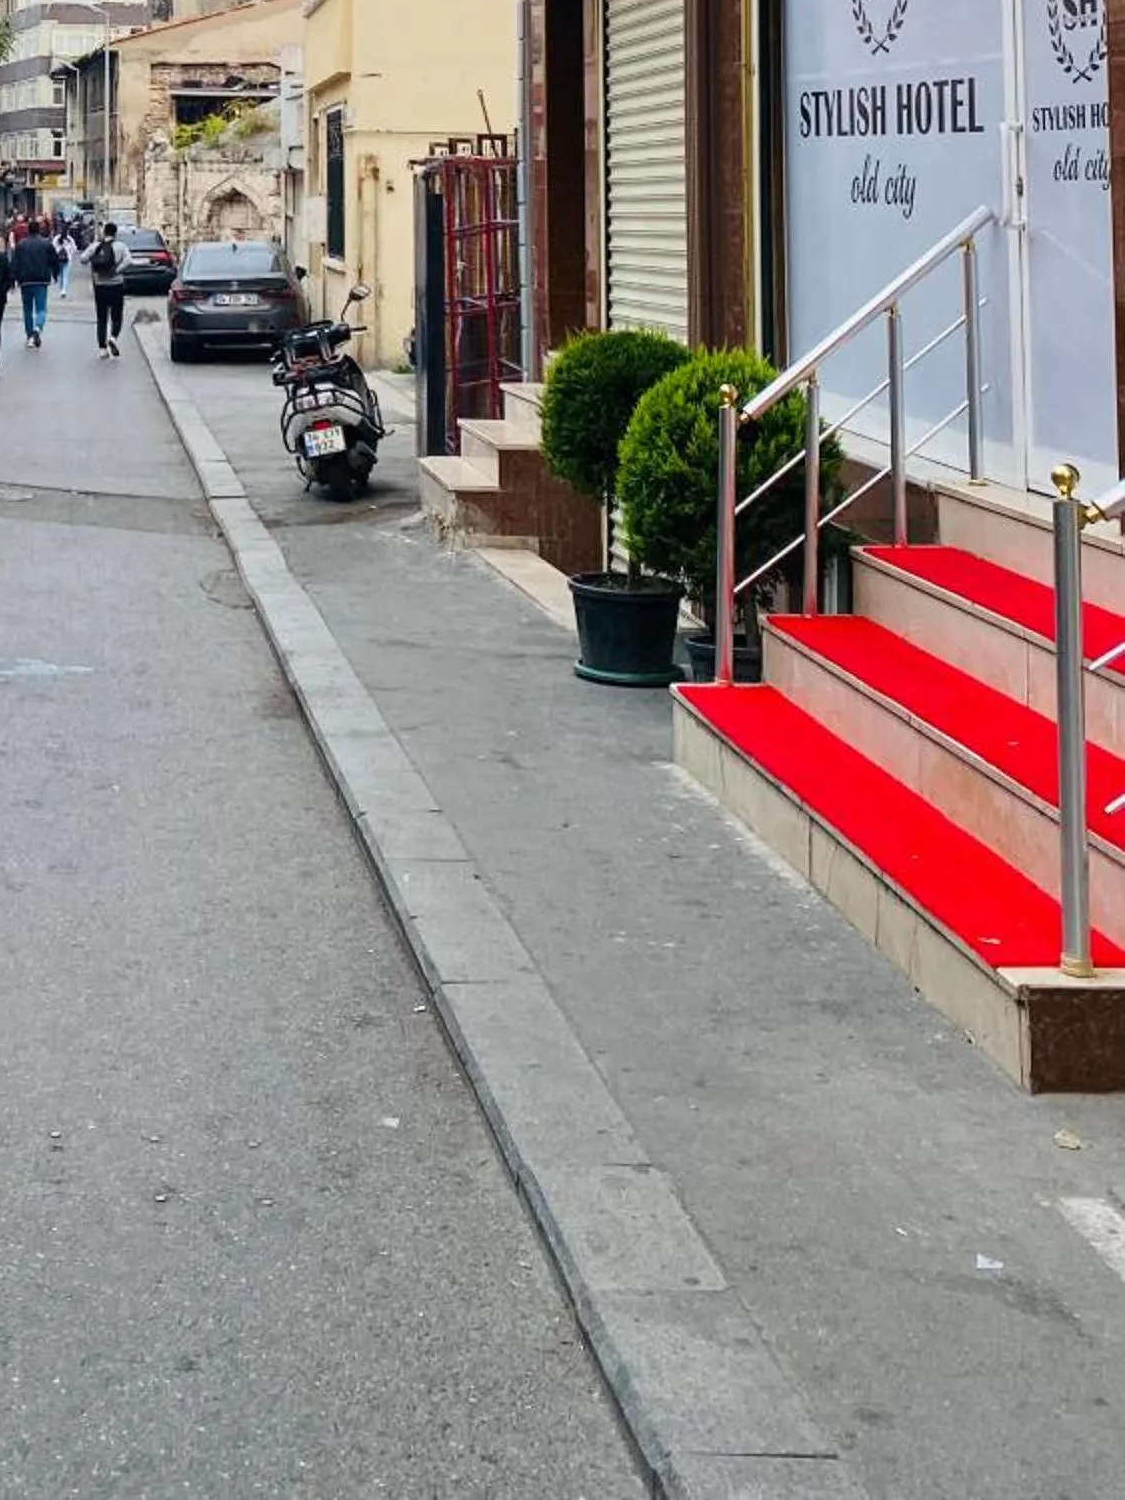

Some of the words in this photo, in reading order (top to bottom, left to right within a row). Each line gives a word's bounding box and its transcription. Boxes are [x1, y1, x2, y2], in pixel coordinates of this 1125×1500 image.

[799, 84, 887, 138] STYLISH
[896, 76, 984, 135] HOTEL
[1032, 102, 1086, 133] STYLISH
[850, 153, 880, 205] old
[884, 163, 917, 219] city
[1052, 142, 1079, 182] old
